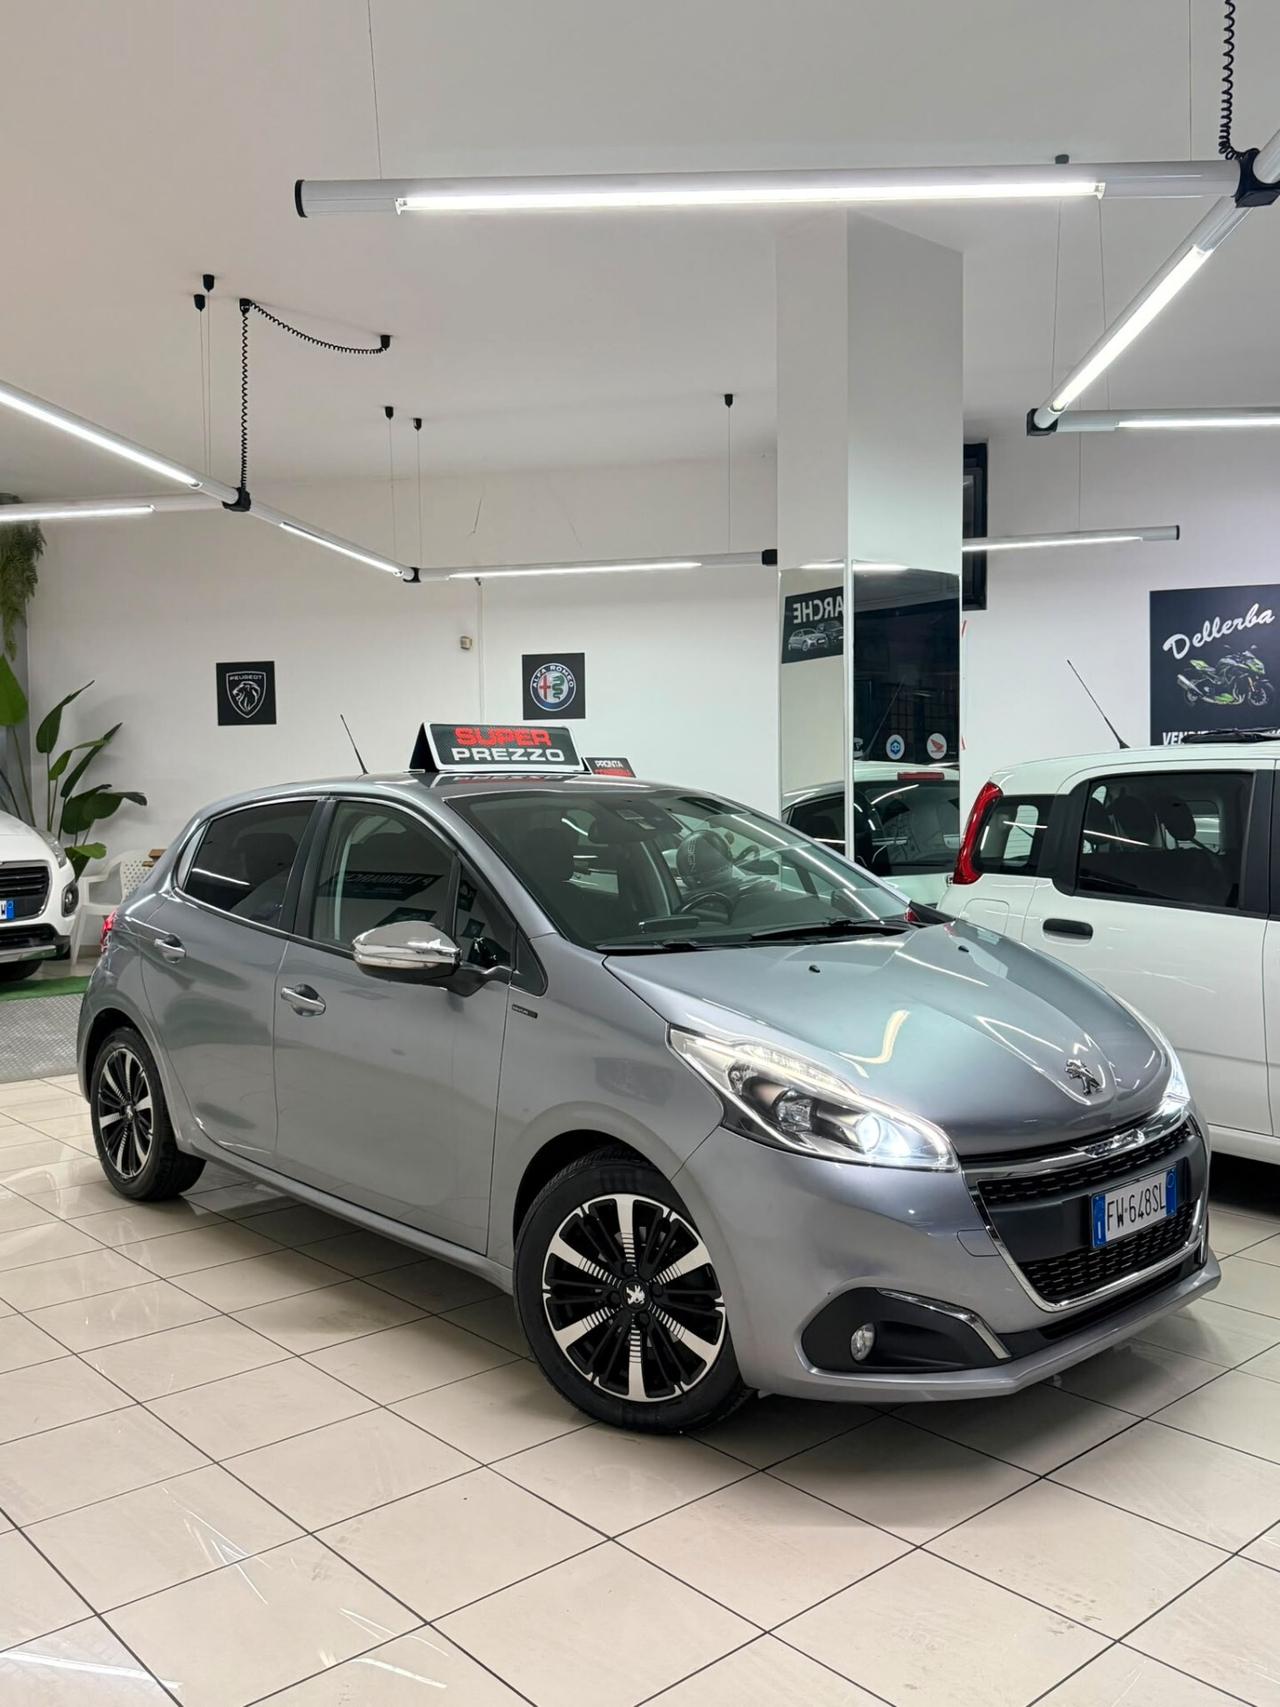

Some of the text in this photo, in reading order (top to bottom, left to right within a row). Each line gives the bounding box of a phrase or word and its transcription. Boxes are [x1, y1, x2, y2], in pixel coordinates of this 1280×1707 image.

[1162, 603, 1276, 660] Dellerba
[532, 665, 574, 688] ALFA ROMEO
[454, 726, 552, 747] SUPER
[451, 747, 565, 762] PREZZO
